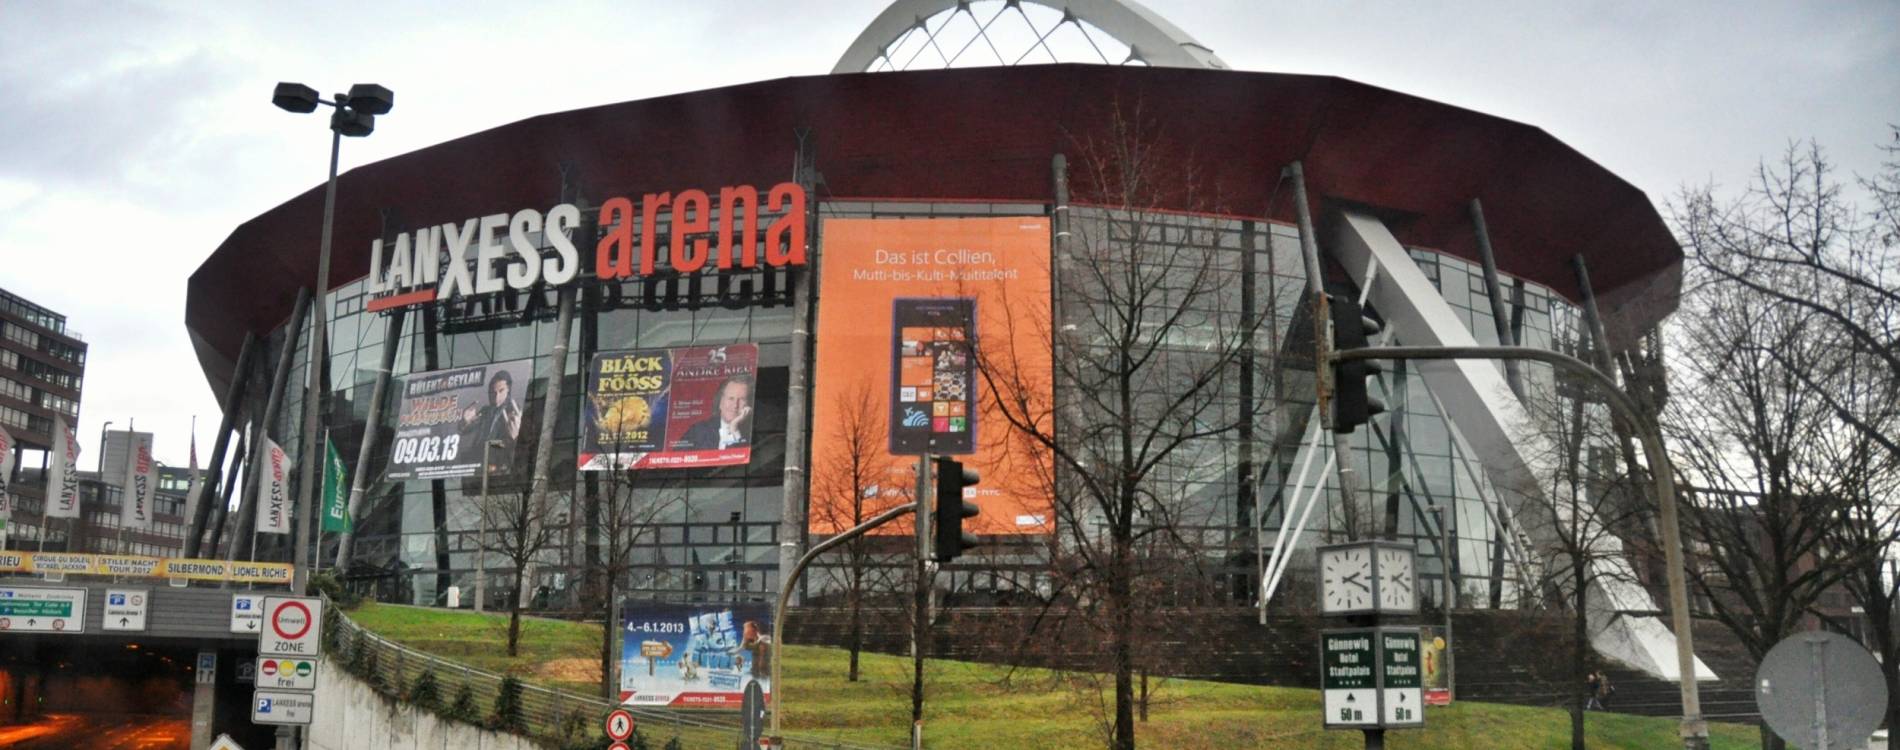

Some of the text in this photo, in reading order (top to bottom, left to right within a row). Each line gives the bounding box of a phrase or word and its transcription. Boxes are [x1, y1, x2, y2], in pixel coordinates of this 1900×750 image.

[369, 182, 807, 300] LANXESS arena
[875, 249, 996, 266] Das ist Collien,
[601, 354, 663, 373] BLÄCK
[448, 371, 482, 386] CEYLAN
[598, 373, 663, 392] FÖÖSS
[393, 434, 460, 464] 09.03.13
[59, 461, 78, 511] LANXESS
[269, 480, 284, 528] LANXESS
[102, 557, 159, 567] STILLE NACHT
[109, 563, 151, 574] TOUR 2012
[168, 562, 224, 576] SILBERMOND
[233, 566, 288, 579] LIONEL RICHIE
[278, 616, 305, 624] Umwelt
[275, 641, 305, 653] ZONE
[1339, 653, 1359, 664] Hotel
[278, 677, 295, 688] frei
[1341, 708, 1363, 721] 50 m
[1395, 708, 1404, 720] 50
